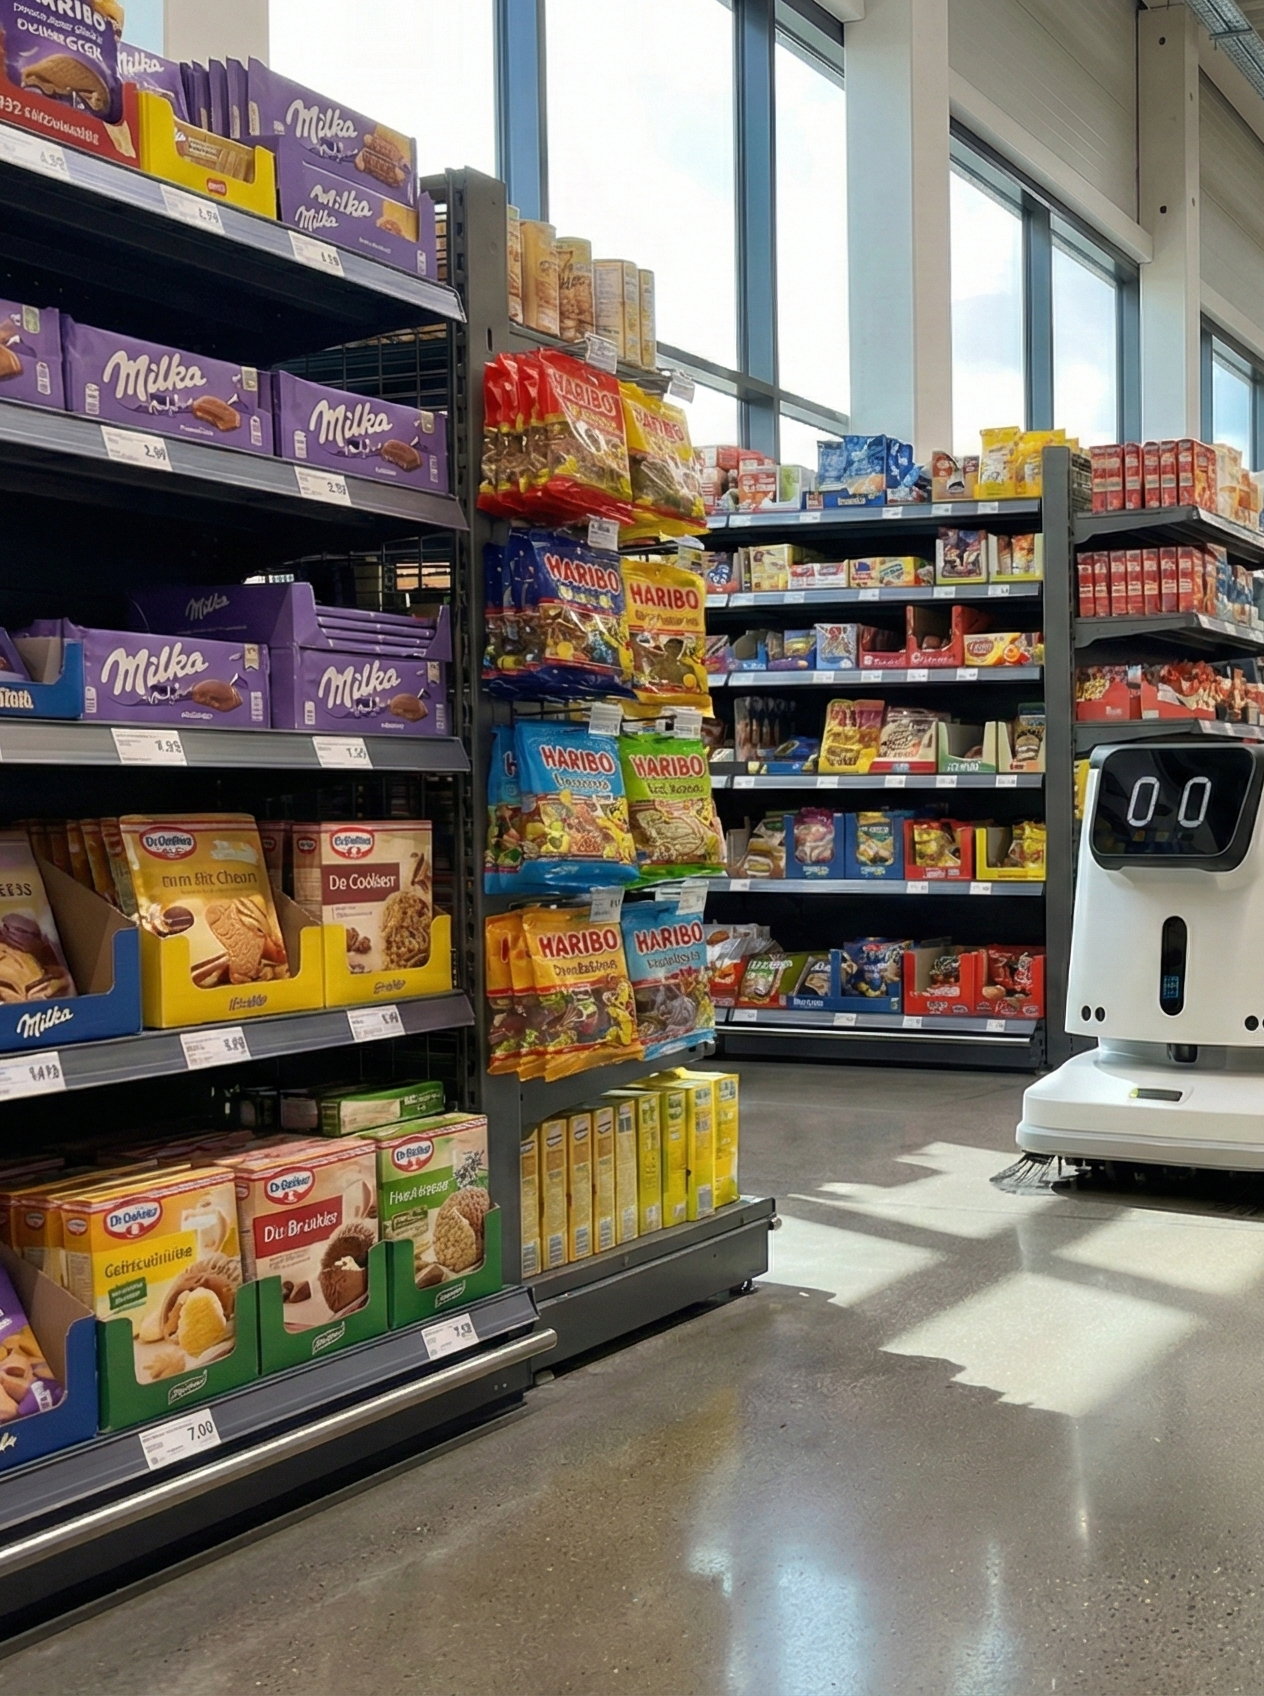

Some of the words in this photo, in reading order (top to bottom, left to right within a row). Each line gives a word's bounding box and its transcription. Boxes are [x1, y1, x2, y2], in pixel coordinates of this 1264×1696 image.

[286, 99, 358, 144] Milka
[310, 184, 373, 218] Milka
[295, 205, 339, 232] Milka
[103, 350, 207, 401] Milka
[309, 399, 393, 446] Milka
[544, 553, 620, 595] HARIBO
[185, 592, 230, 621] Milka
[629, 583, 699, 610] HARIBO
[101, 641, 209, 694] Milka
[318, 659, 402, 710] Milka
[541, 745, 615, 774] HARIBO
[634, 754, 705, 778] HARIBO
[538, 928, 620, 960] HARIBO
[634, 920, 704, 955] HARIBO
[16, 1005, 74, 1039] Milka
[187, 1420, 214, 1441] 7.00
